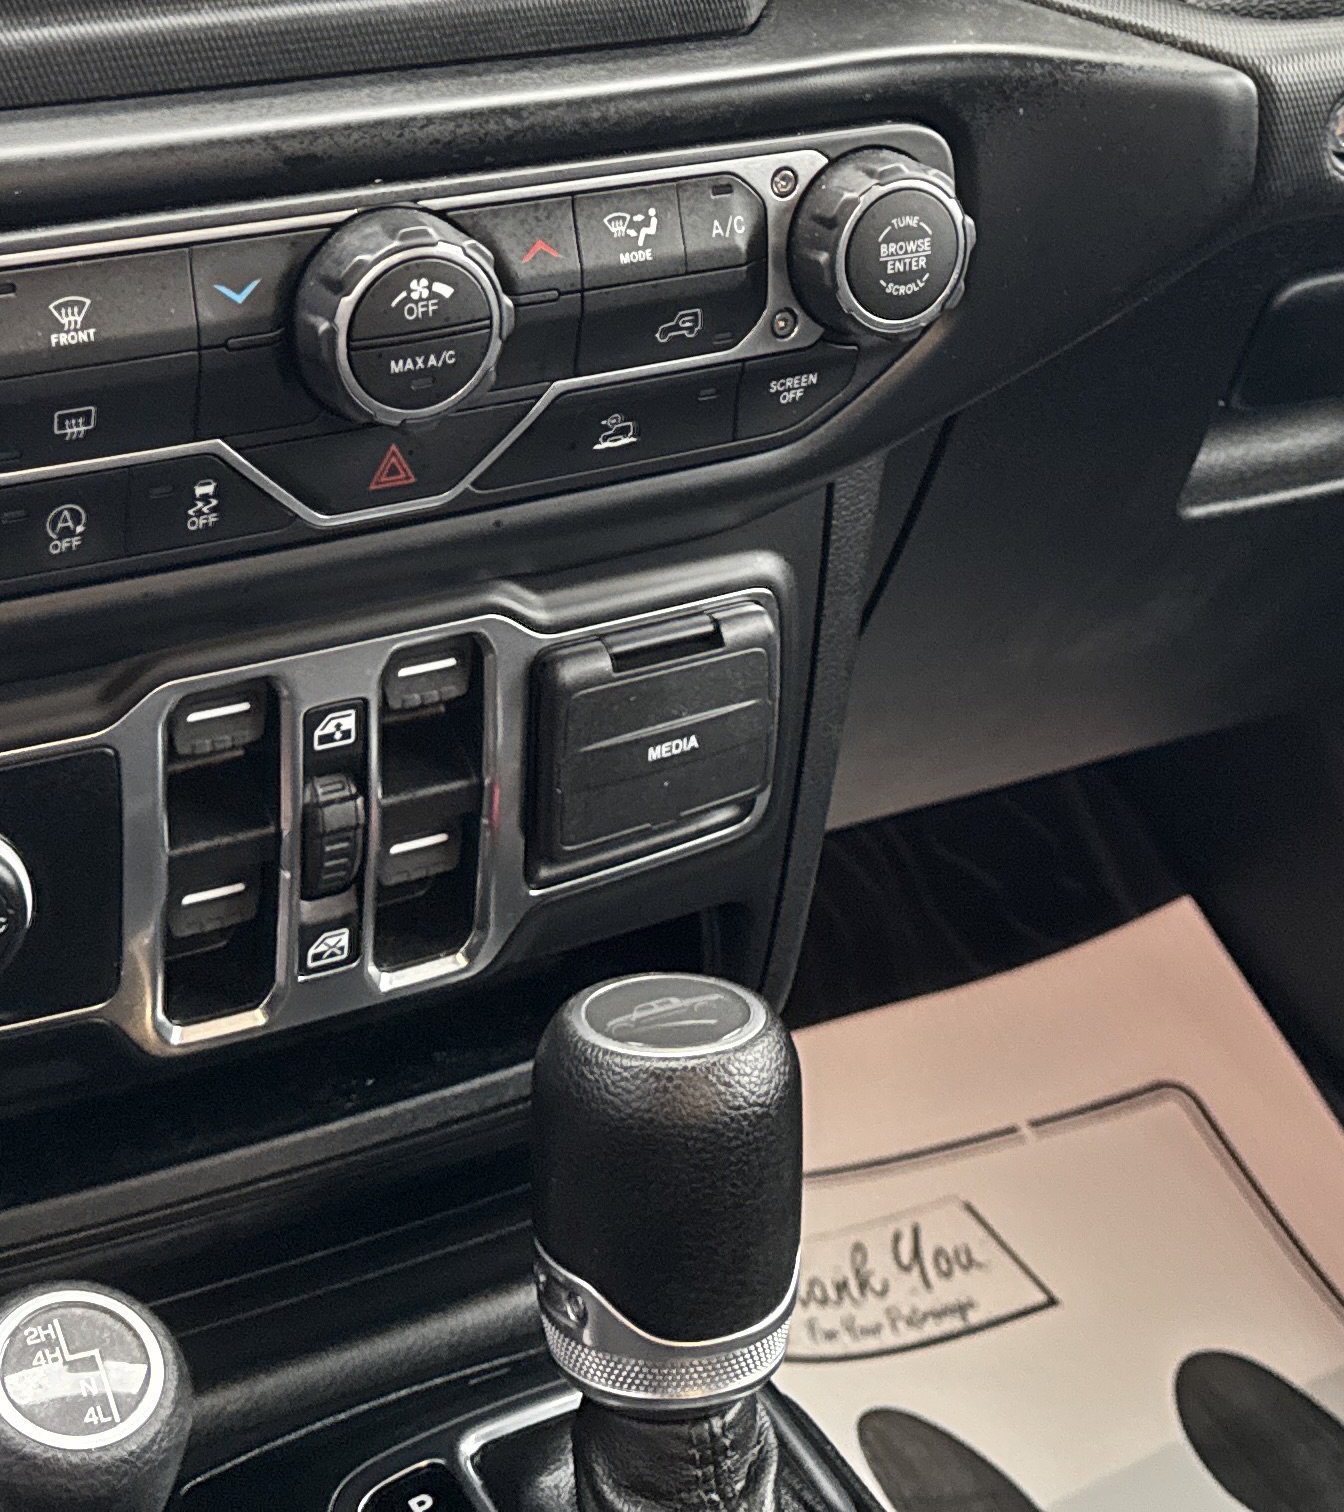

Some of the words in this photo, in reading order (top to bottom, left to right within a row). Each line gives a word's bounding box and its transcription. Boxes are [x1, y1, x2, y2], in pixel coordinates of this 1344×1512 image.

[712, 215, 745, 238] A/C
[891, 216, 920, 230] TUNE
[619, 248, 654, 265] MODE
[880, 238, 932, 257] BROWSE
[887, 257, 927, 274] ENTER
[885, 279, 925, 296] SCROLL
[404, 299, 439, 320] OFF
[51, 328, 96, 347] FRONT
[390, 356, 425, 374] MAX
[427, 350, 456, 367] A/C
[769, 372, 818, 393] SCREEN
[779, 389, 805, 404] OFF
[187, 513, 220, 531] OFF
[49, 537, 82, 555] OFF
[647, 734, 699, 762] MEDIA
[892, 1222, 988, 1290] You
[23, 1324, 56, 1345] 2H
[32, 1347, 63, 1367] 4H
[80, 1377, 98, 1397] N
[84, 1405, 112, 1425] 4L
[408, 1494, 433, 1512] P
